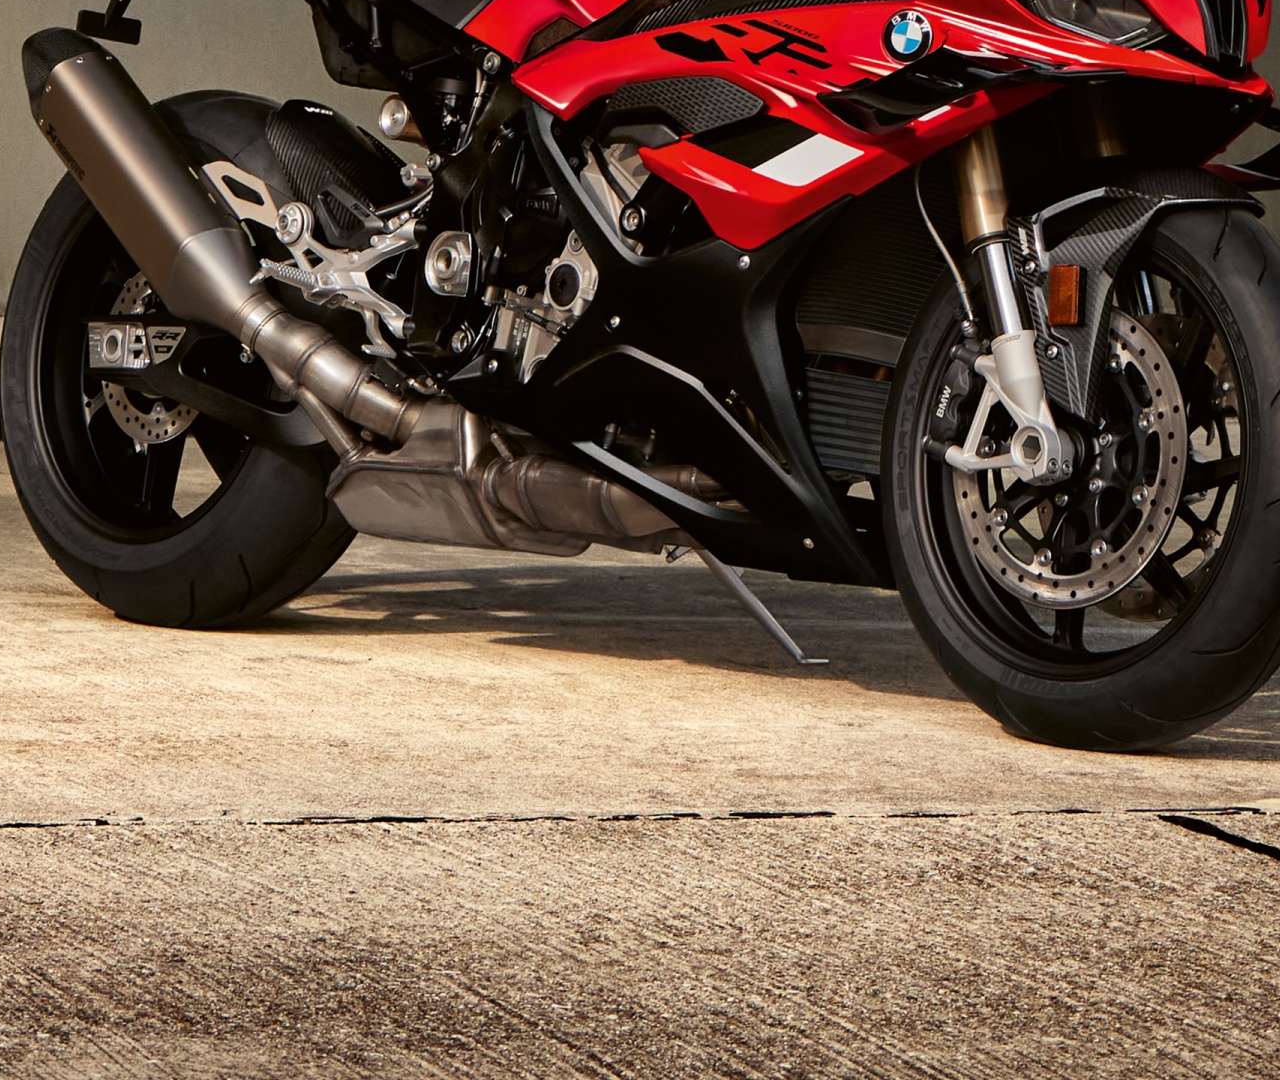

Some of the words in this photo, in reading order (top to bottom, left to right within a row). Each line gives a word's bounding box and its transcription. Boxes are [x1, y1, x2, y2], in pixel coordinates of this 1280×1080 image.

[772, 18, 820, 41] S1000
[891, 11, 932, 33] BMW
[151, 330, 181, 341] RR
[936, 385, 952, 418] BMW
